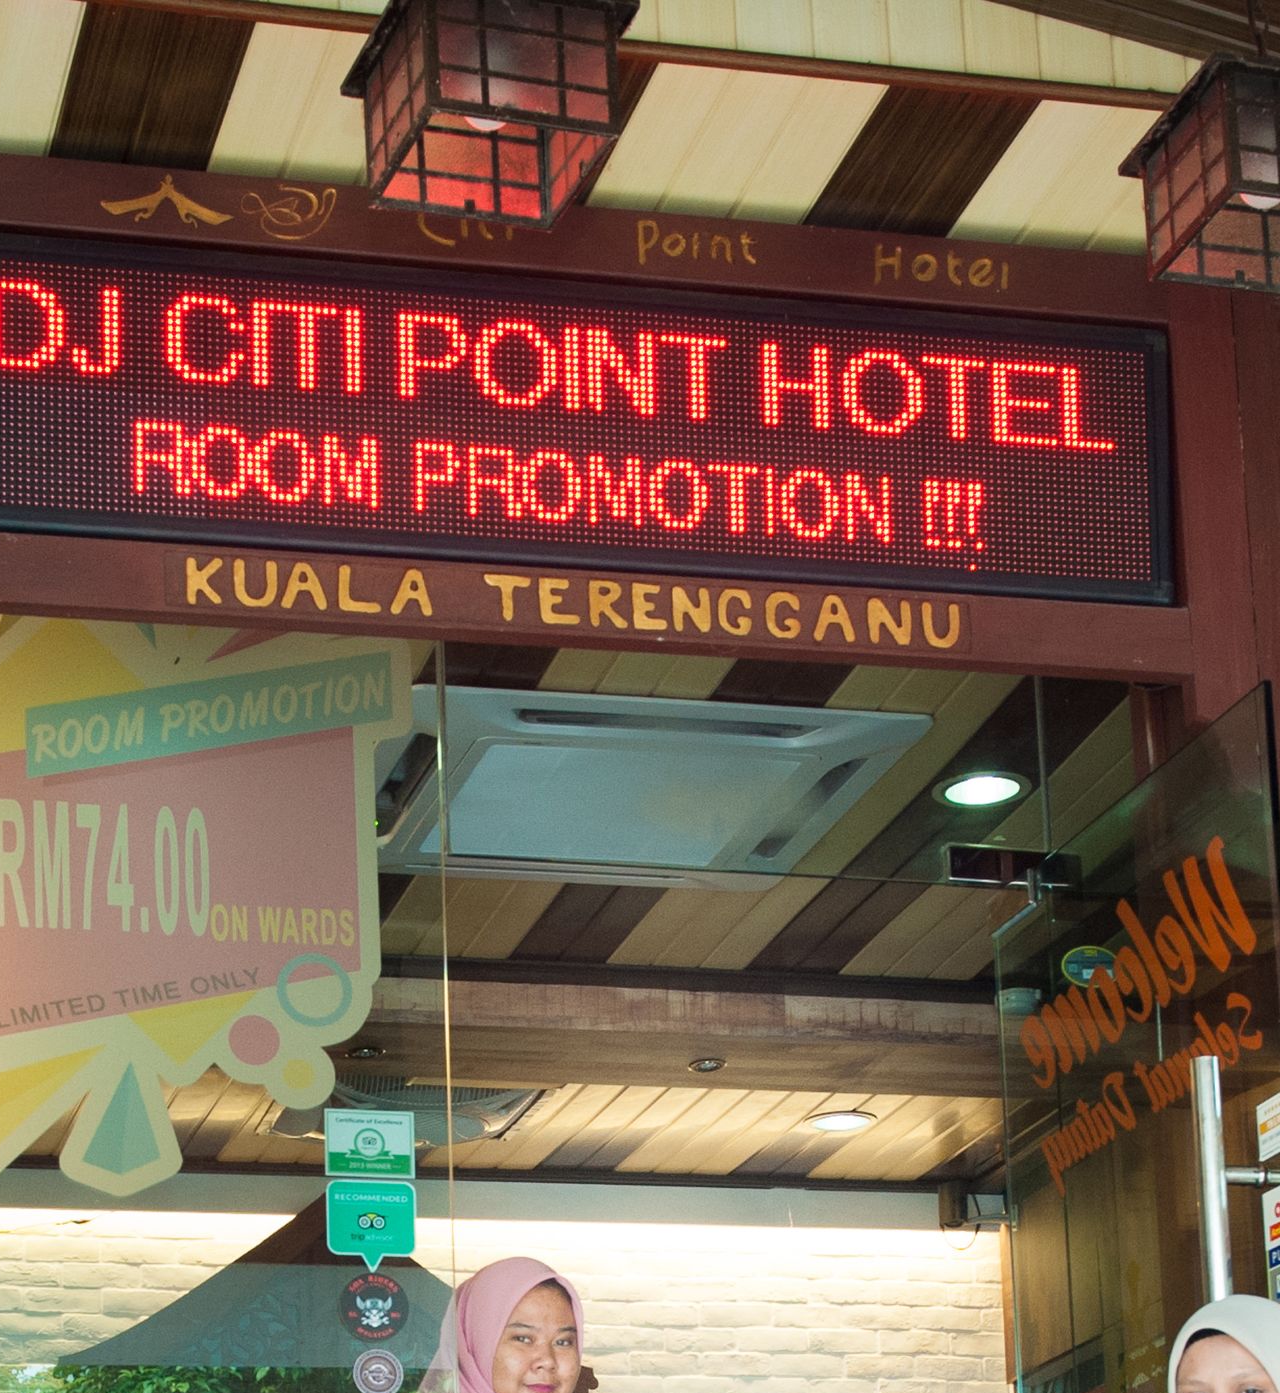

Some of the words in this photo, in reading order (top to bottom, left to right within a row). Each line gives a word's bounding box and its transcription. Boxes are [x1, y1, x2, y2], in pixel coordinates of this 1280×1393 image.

[637, 219, 758, 266] Point
[874, 244, 1010, 290] Hotel
[165, 294, 362, 394] CITI
[397, 310, 728, 422] POINT
[762, 342, 1116, 452] HOTEL
[133, 420, 380, 509] ROOM
[413, 440, 893, 545] PROMOTION
[185, 556, 433, 618] KUALA
[483, 572, 961, 650] TERENGGANU
[31, 706, 144, 763] ROOM
[159, 668, 387, 742] PROMOTION
[210, 903, 249, 943] ON
[258, 905, 355, 947] WARDS
[113, 978, 180, 1010] TIME
[188, 966, 261, 999] ONLY
[334, 1193, 409, 1204] RECOMMENDED
